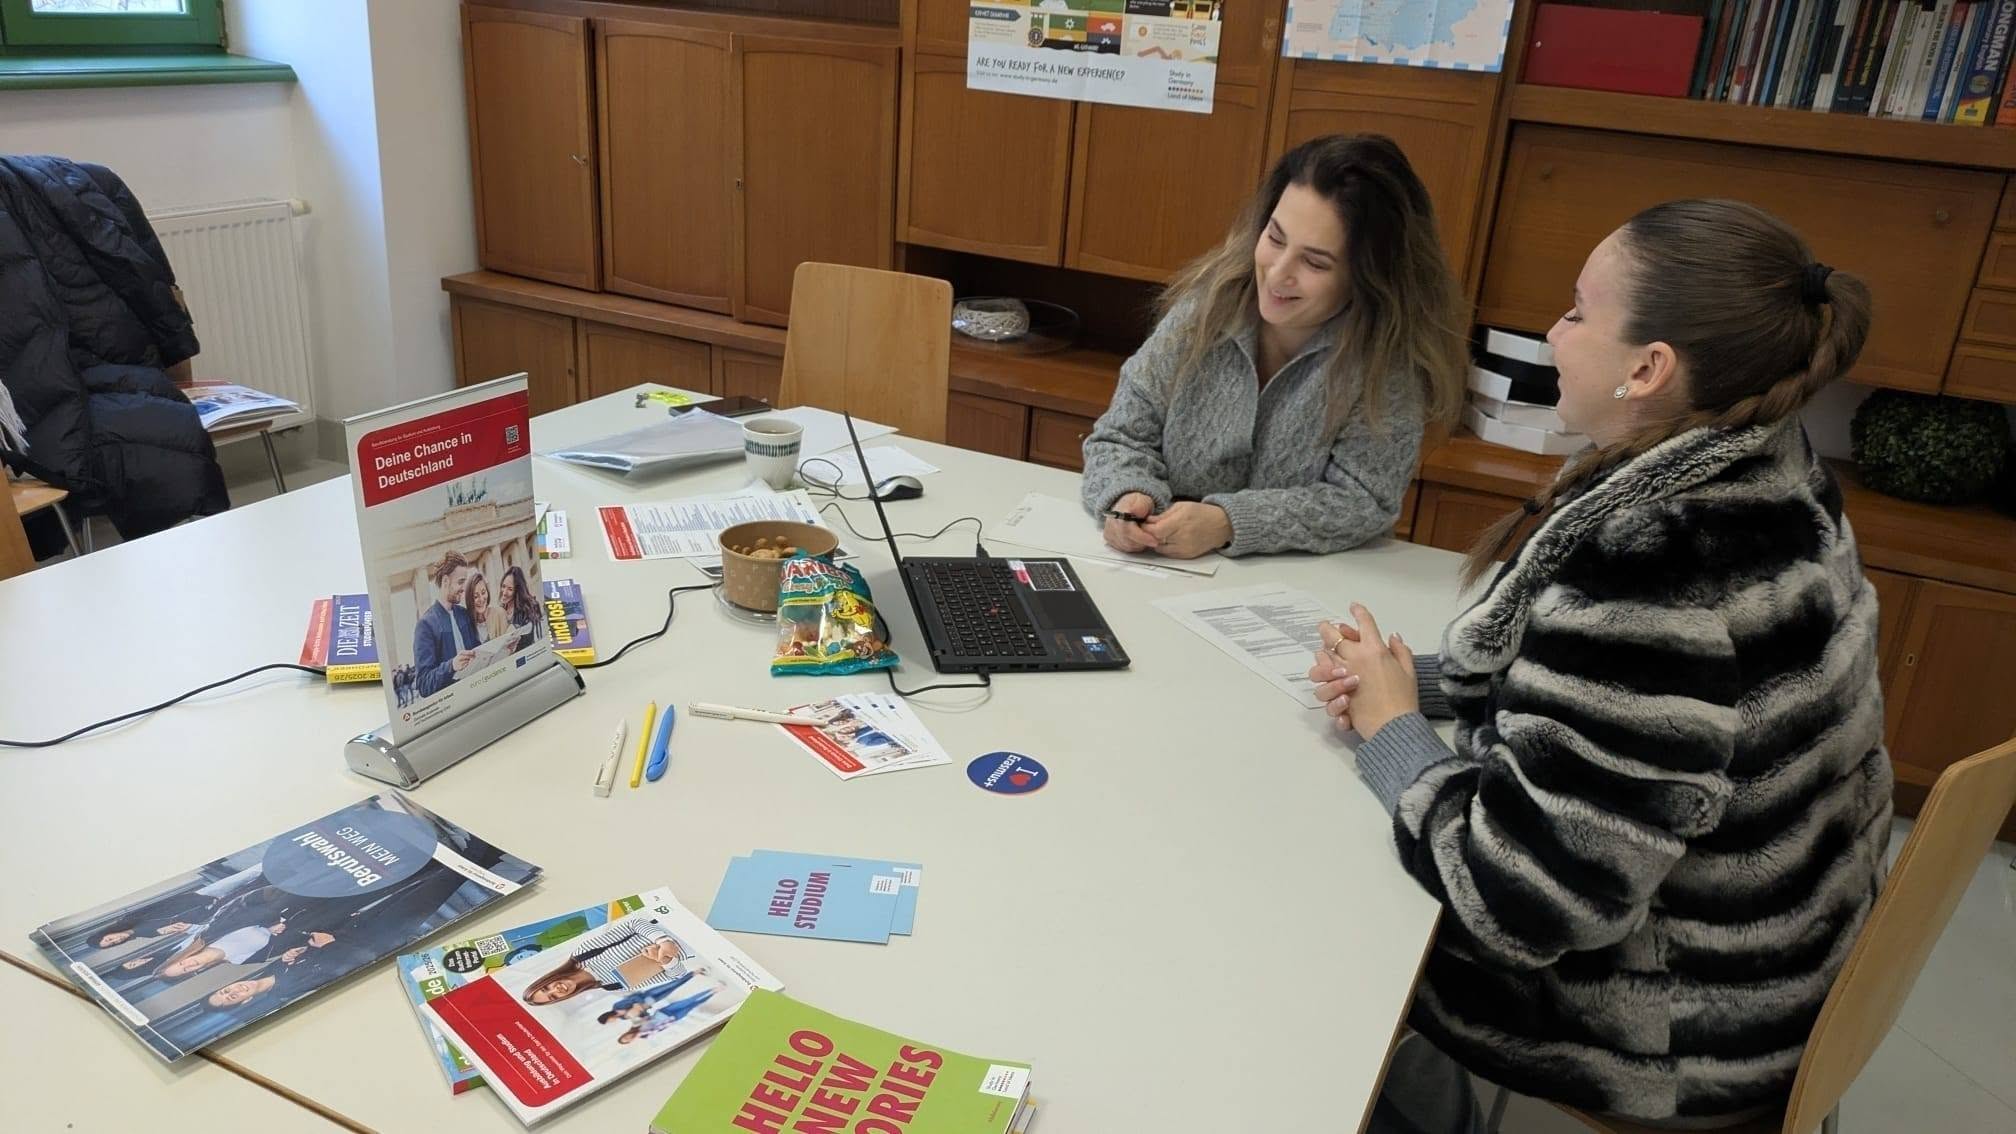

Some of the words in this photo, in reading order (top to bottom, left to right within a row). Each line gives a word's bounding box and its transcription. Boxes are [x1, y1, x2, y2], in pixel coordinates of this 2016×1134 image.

[1985, 0, 2009, 71] ONGMAN
[976, 56, 991, 68] ARE
[992, 58, 1006, 69] YOU
[1008, 60, 1031, 72] READY
[1034, 62, 1048, 73] FOR
[1049, 64, 1055, 74] A
[1058, 64, 1074, 76] NEW
[1077, 67, 1127, 80] EXPERIENCE?
[1169, 69, 1185, 79] Study
[1168, 77, 1194, 87] Germany
[1167, 92, 1180, 100] Land
[1188, 94, 1204, 102] Ideas
[375, 452, 411, 470] Deine
[414, 437, 458, 458] Chance
[461, 432, 472, 445] in
[378, 455, 454, 489] Deutschland
[339, 605, 360, 627] ZEIT
[545, 600, 567, 621] los!
[550, 622, 573, 644] und
[336, 640, 358, 656] DIE
[984, 754, 1021, 788] Erasmus+
[1016, 766, 1039, 777] I
[335, 826, 368, 847] WEG
[291, 831, 383, 887] Berufswahl
[361, 842, 400, 865] MEIN
[768, 879, 799, 917] HELLO
[793, 872, 831, 930] STUDIUM
[425, 978, 445, 995] de
[495, 1033, 517, 1054] Studium
[512, 1051, 526, 1062] und
[523, 1048, 555, 1079] Deutschland
[550, 1077, 561, 1086] in
[732, 1029, 835, 1134] HELLO
[854, 1045, 944, 1134] ORIES
[793, 1053, 880, 1134] NEW
